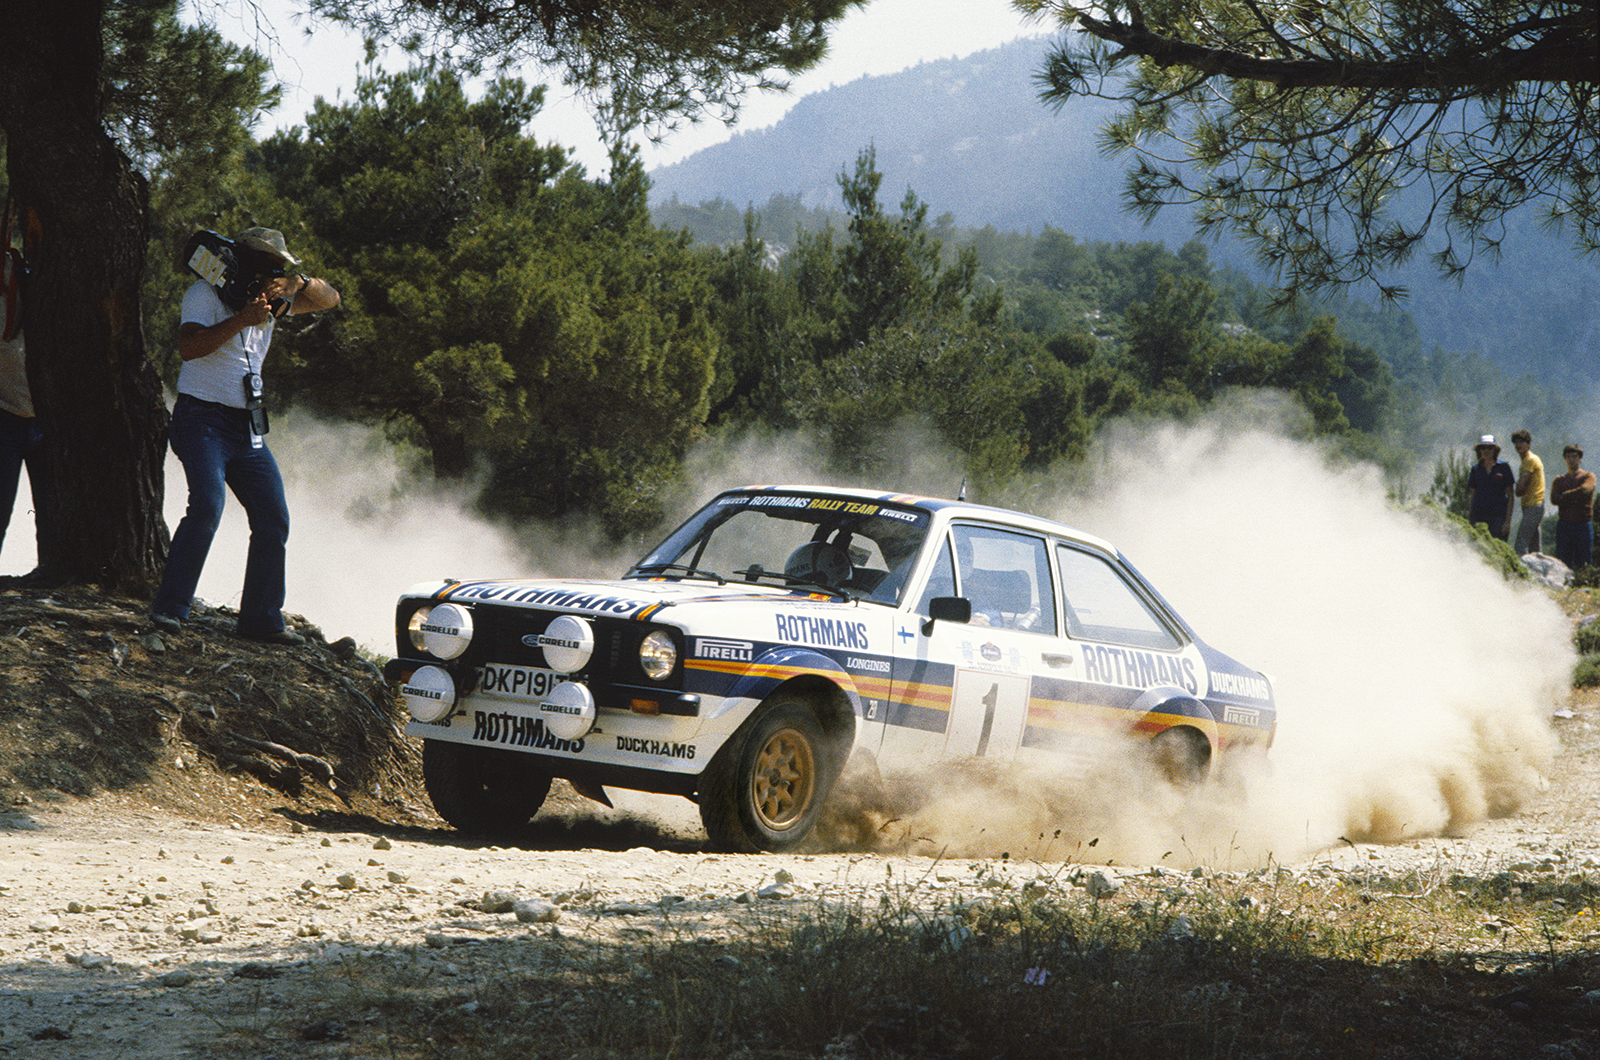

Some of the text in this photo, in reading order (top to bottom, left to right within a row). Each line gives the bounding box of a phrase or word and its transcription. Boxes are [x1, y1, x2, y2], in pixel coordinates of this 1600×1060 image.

[748, 496, 811, 509] ROTHMANS
[807, 499, 845, 511] RALLY
[844, 502, 880, 516] TEAM
[878, 508, 918, 522] PIRELLI
[457, 585, 639, 613] ROTHMANS
[420, 623, 459, 636] CARELLO
[775, 613, 869, 650] ROTHMANS
[538, 636, 580, 649] CARELLO
[694, 638, 754, 661] PIRELLI
[846, 657, 891, 672] LONGINES
[1080, 643, 1198, 696] ROTHMANS
[402, 686, 441, 700] CARELLO
[1210, 671, 1270, 700] DUCKHAMS
[540, 703, 581, 716] CARELLO
[975, 682, 999, 757] 1
[1223, 705, 1260, 727] PIRELLI
[616, 736, 696, 760] DUCKHAMS
